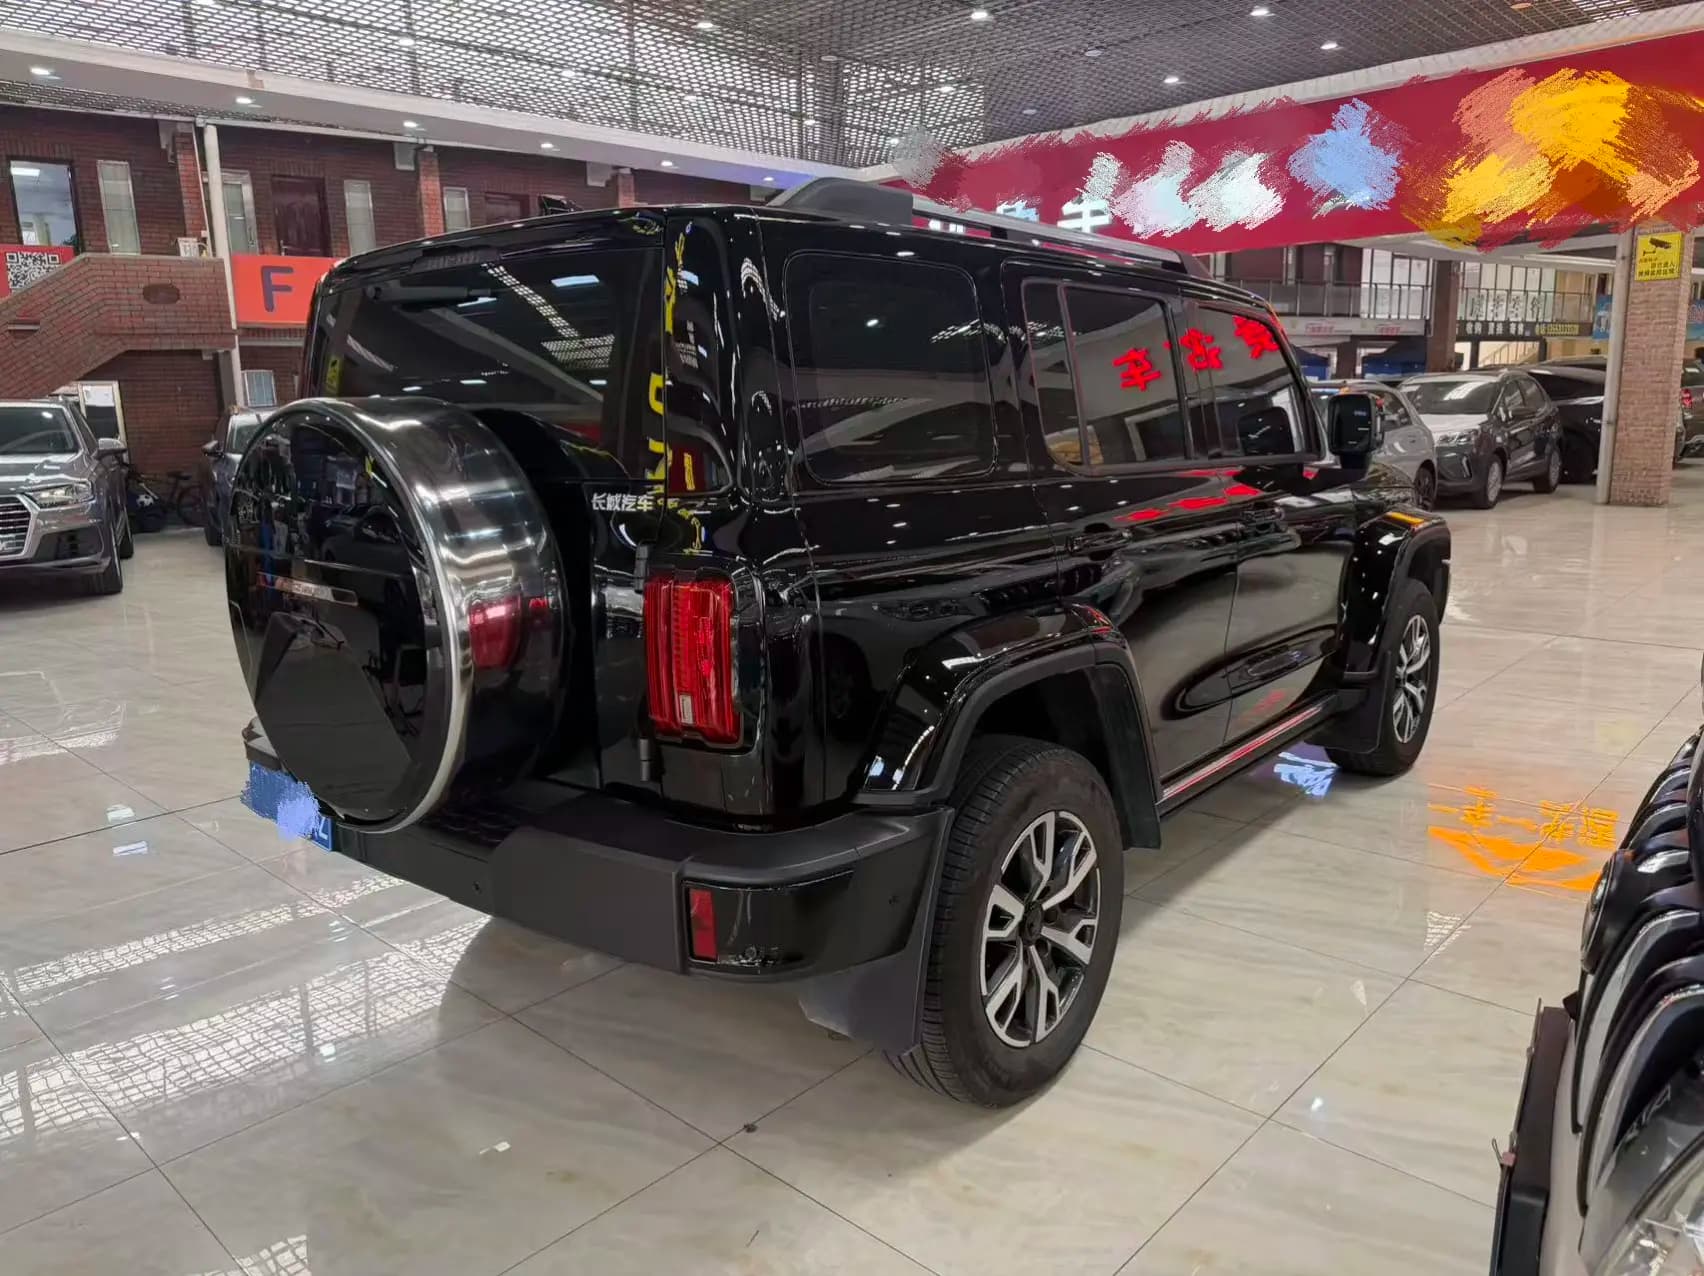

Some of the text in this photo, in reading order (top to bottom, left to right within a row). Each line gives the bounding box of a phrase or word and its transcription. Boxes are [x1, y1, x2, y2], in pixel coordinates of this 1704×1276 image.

[261, 266, 294, 313] F
[591, 492, 655, 511] 长城汽车
